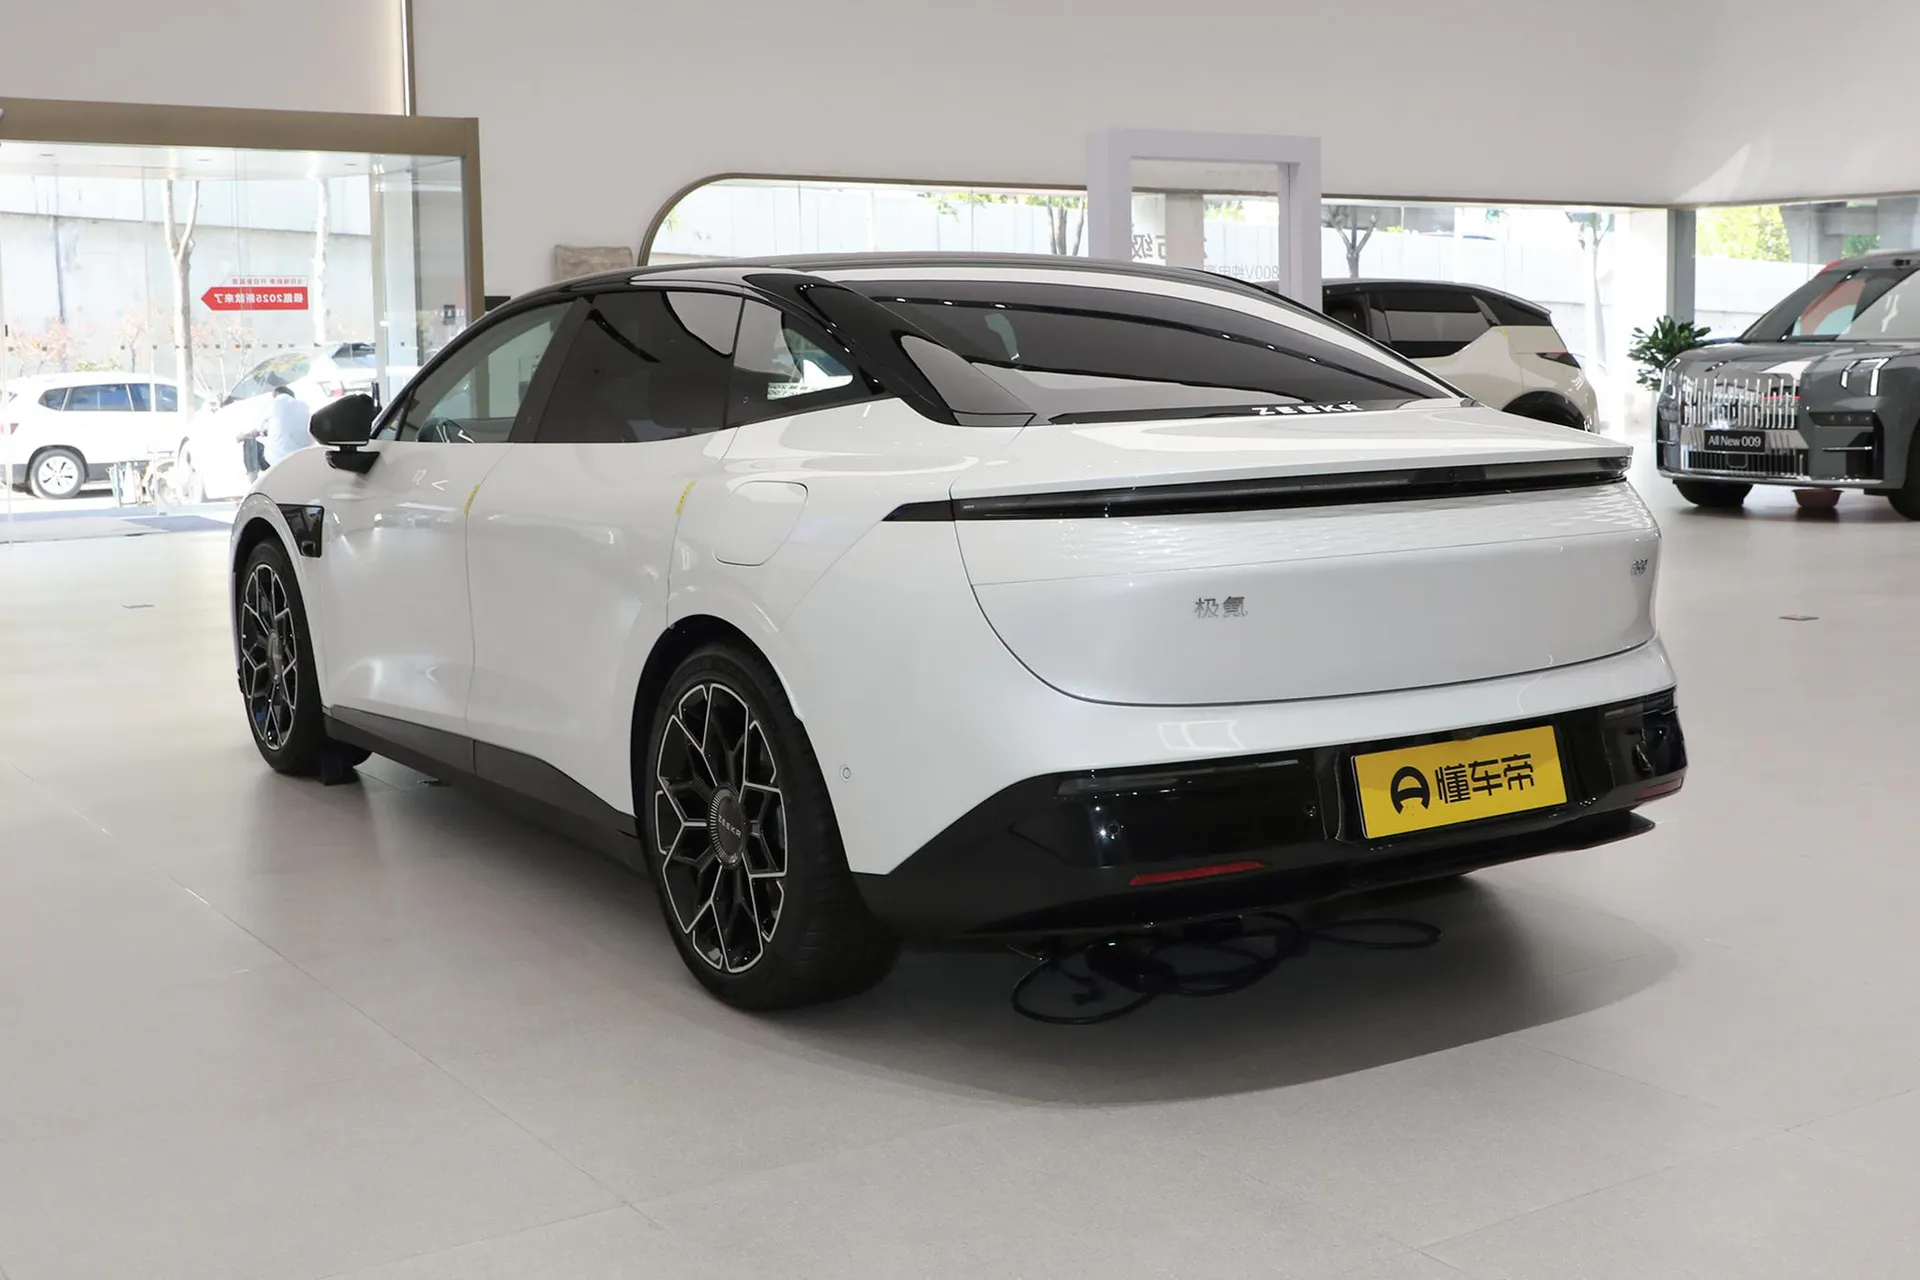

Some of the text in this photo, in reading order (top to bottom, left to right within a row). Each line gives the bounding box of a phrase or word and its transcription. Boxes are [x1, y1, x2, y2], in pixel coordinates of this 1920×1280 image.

[1251, 402, 1364, 416] ZEEKR
[1708, 435, 1761, 447] All New 009
[1194, 596, 1249, 618] 极氪
[1434, 753, 1535, 804] 懂车帝
[717, 815, 742, 838] ZEEKR
